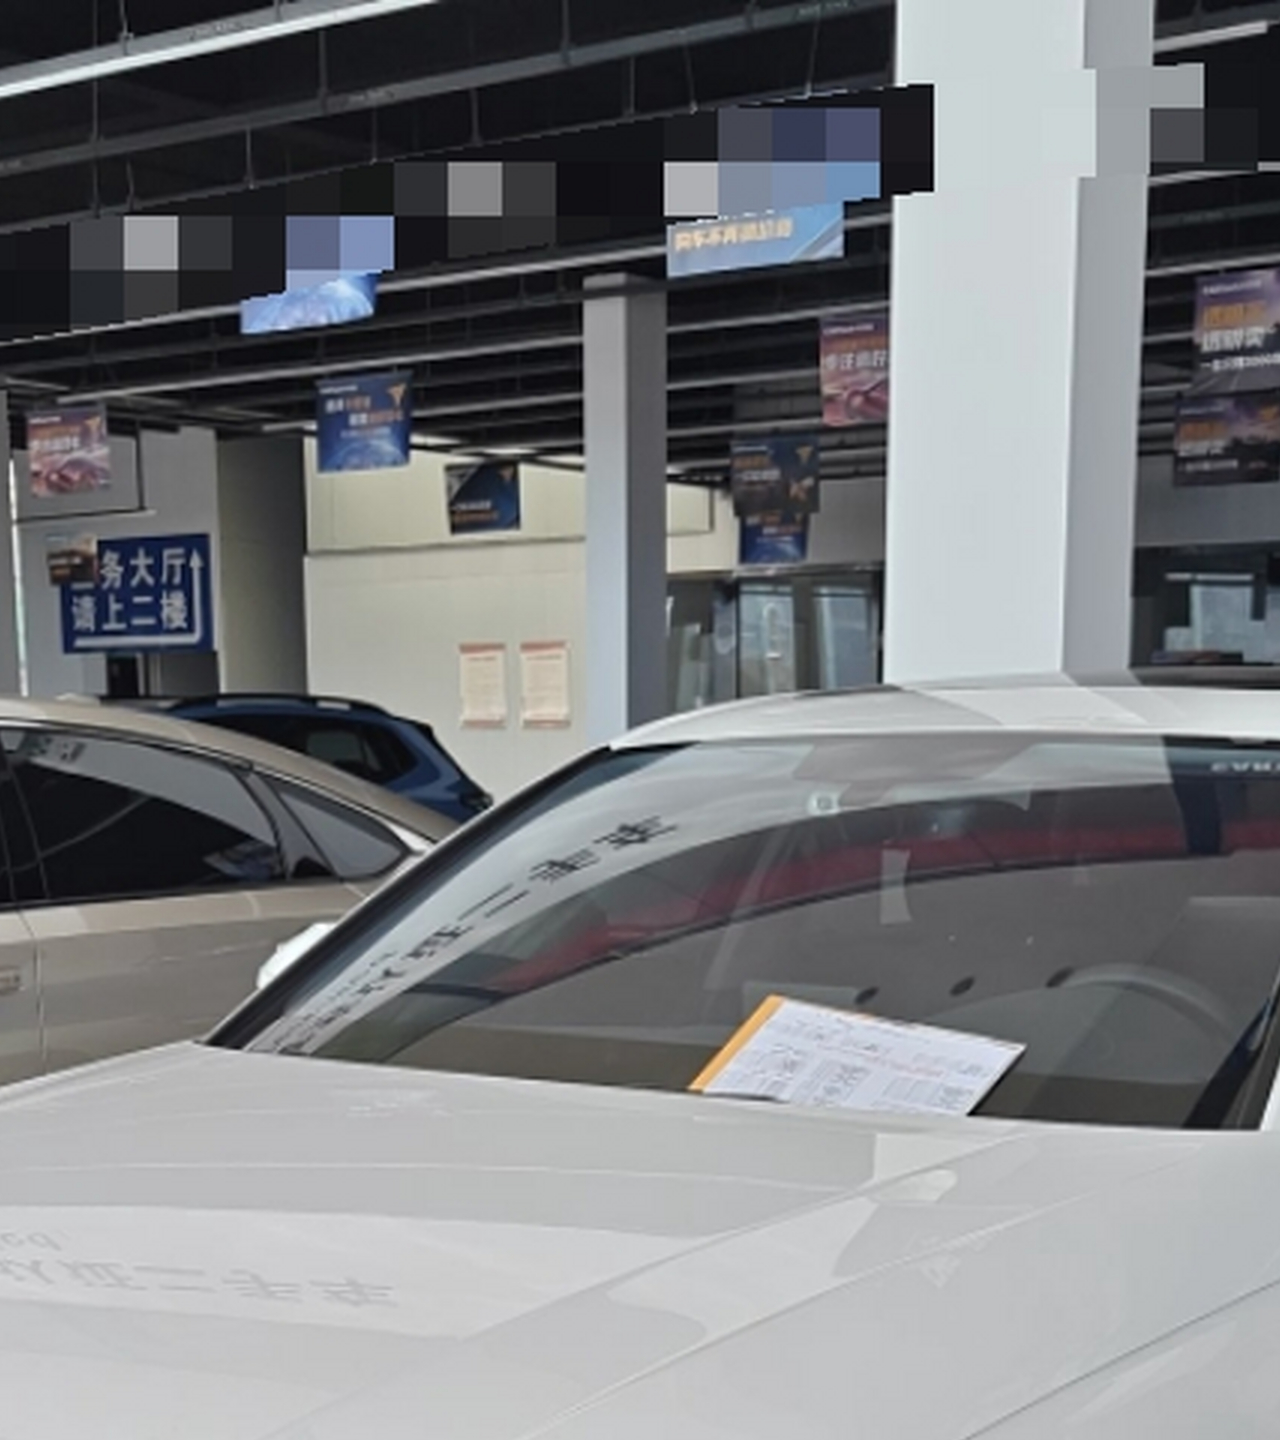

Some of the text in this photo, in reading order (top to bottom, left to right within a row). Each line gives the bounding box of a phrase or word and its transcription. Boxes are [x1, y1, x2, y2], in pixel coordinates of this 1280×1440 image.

[71, 548, 186, 590] 务大厅
[72, 589, 188, 632] 请上二楼
